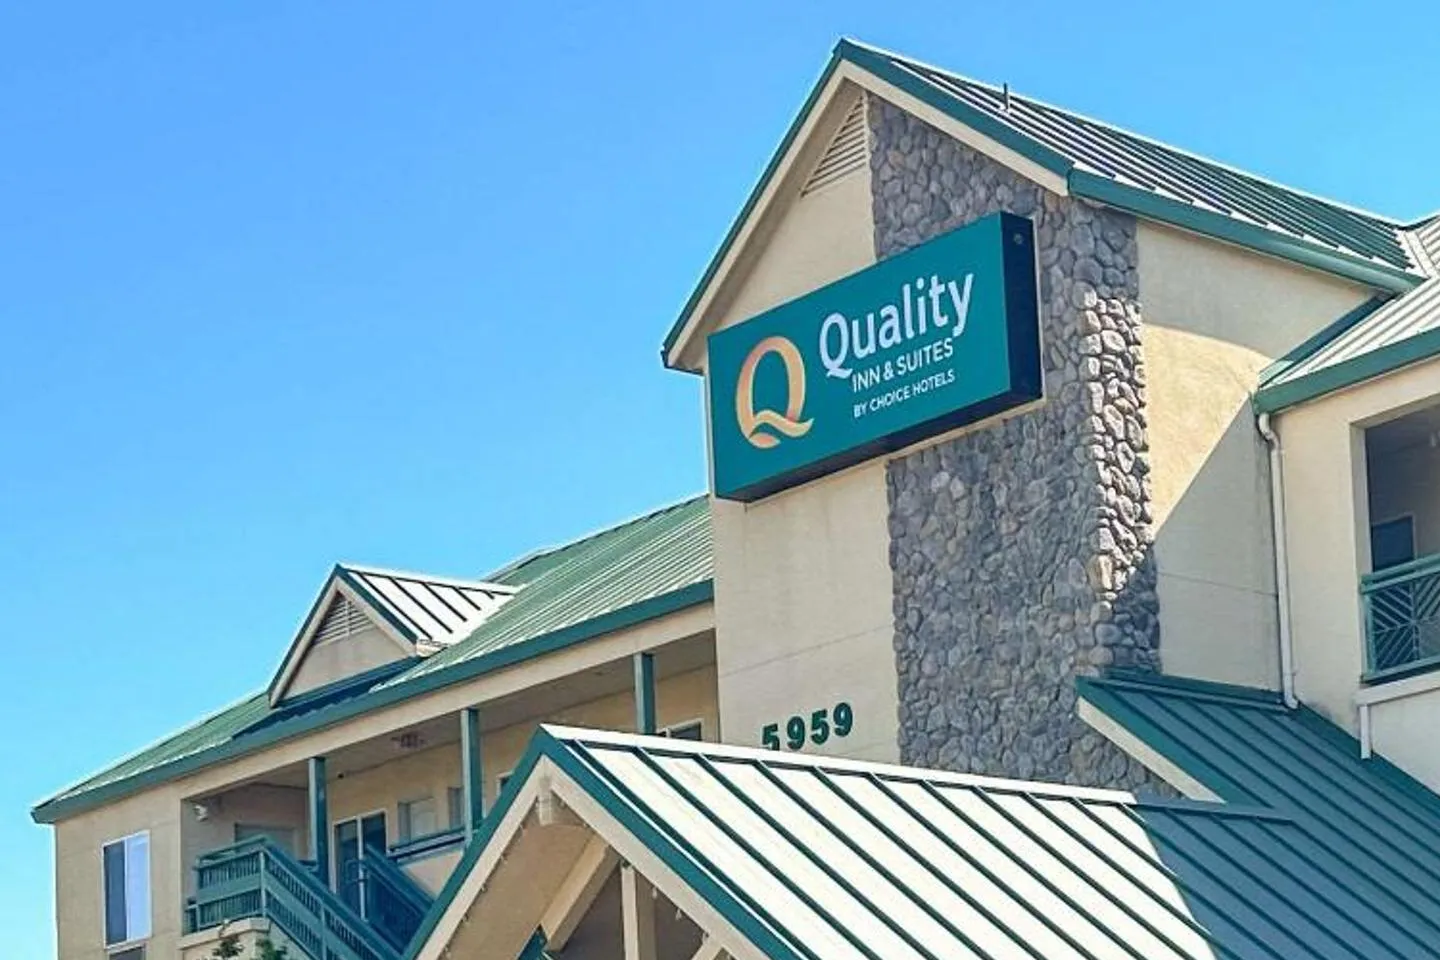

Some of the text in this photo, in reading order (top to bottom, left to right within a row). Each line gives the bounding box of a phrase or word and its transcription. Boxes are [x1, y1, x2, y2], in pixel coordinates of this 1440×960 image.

[819, 273, 974, 378] Quality
[852, 337, 953, 393] INN & SUITES
[853, 368, 955, 418] BY CHOICE HOTELS
[762, 702, 853, 751] 5959
